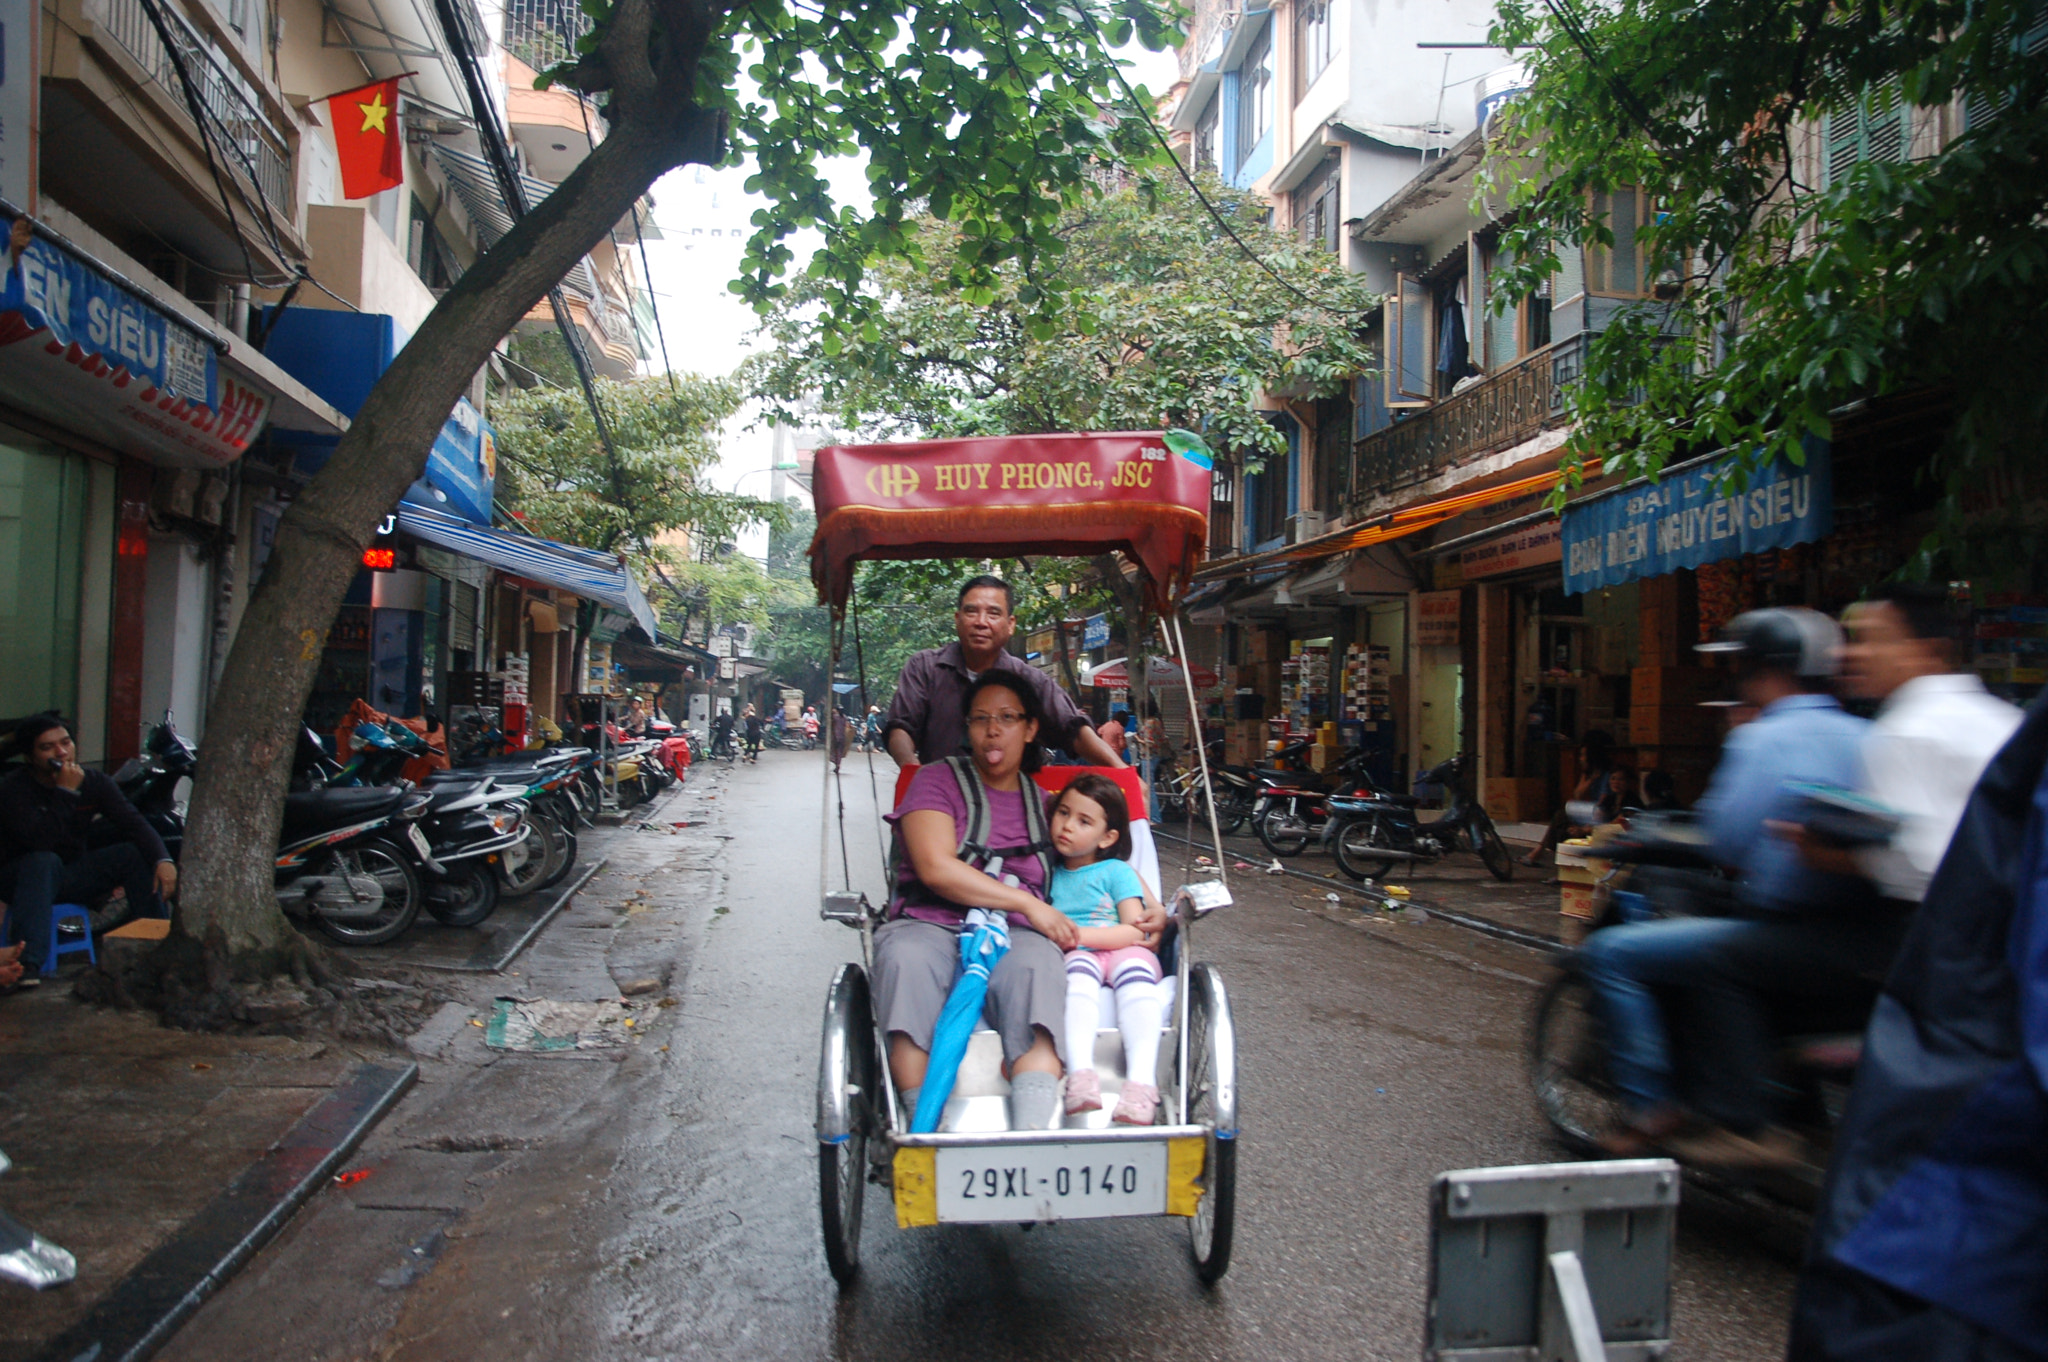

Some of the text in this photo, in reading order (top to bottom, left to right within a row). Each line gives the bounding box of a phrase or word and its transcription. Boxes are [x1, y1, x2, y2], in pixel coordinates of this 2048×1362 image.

[87, 296, 160, 369] SIÊU
[1139, 447, 1167, 462] 182
[934, 463, 993, 491] HUY
[1111, 461, 1154, 489] JSC
[1749, 471, 1811, 530] SIÊU
[961, 1164, 1137, 1198] 29XL-0140
